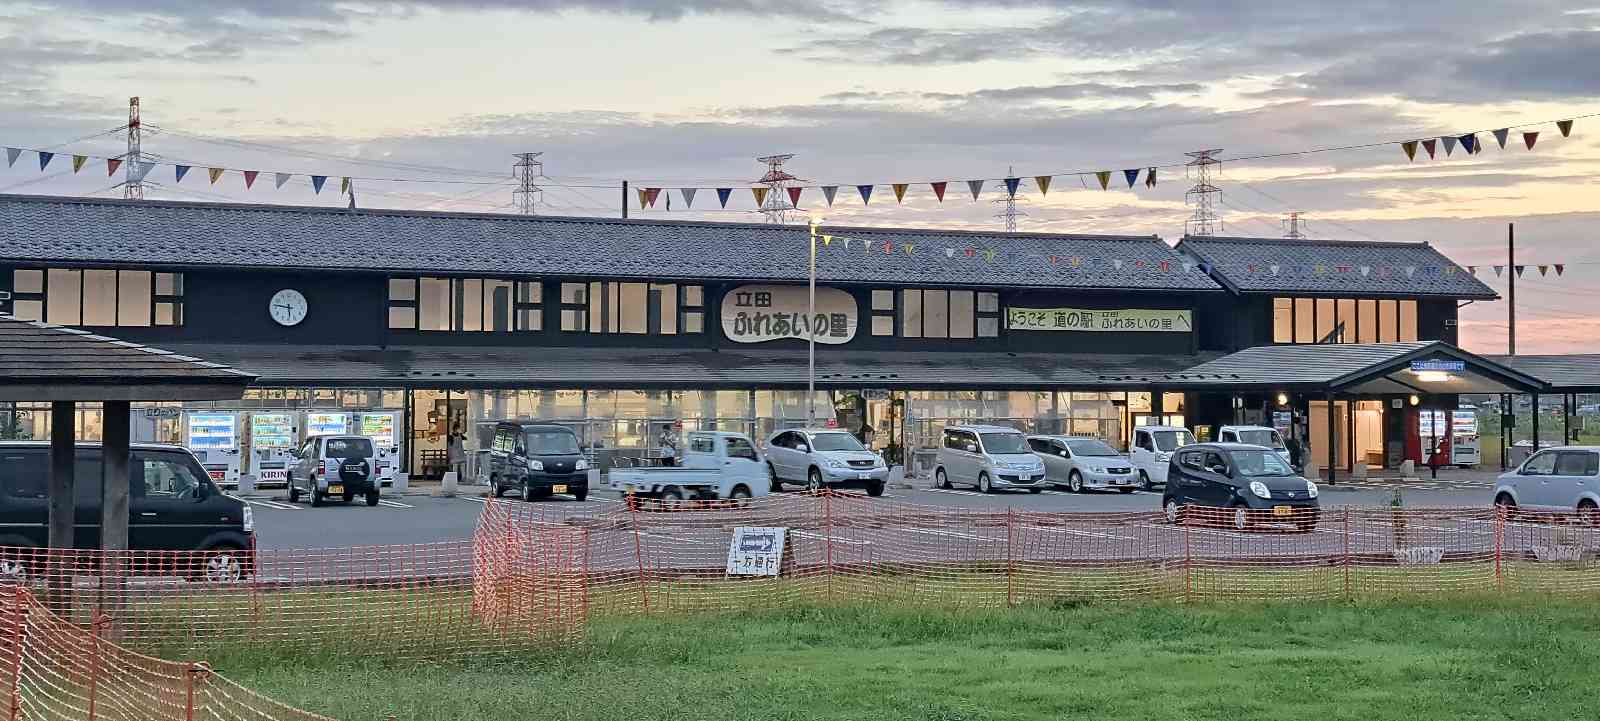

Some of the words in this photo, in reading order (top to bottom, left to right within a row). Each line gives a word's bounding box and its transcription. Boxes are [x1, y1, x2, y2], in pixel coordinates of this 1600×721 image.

[735, 292, 771, 307] 立田
[733, 312, 848, 337] ふれあいの里
[1009, 311, 1046, 327] ようこそ
[1054, 311, 1094, 329] 道の駅
[1101, 317, 1173, 330] ふれあいの里
[261, 471, 287, 479] KIRIN
